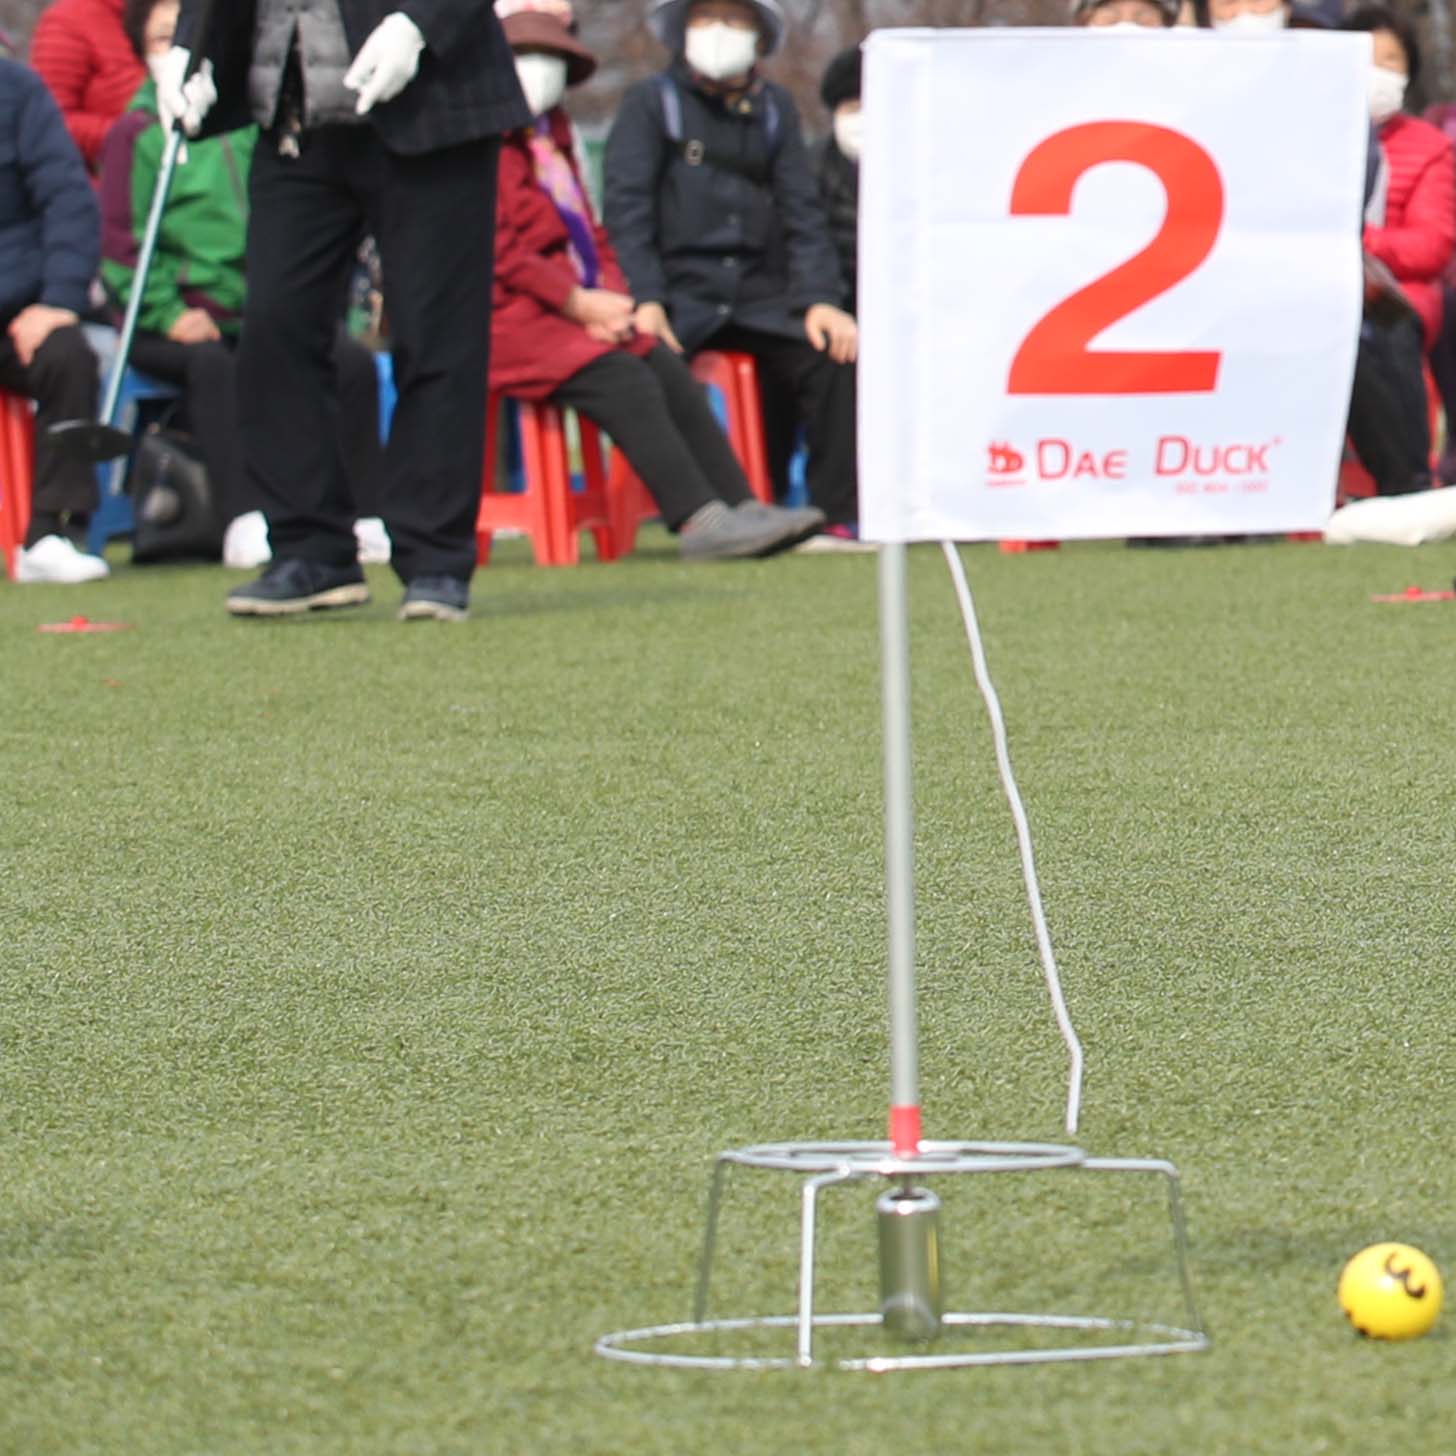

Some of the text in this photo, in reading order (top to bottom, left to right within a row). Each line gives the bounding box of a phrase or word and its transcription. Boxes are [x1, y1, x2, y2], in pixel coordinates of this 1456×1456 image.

[1007, 119, 1226, 397] 2
[1034, 434, 1269, 480] DAE DUCK
